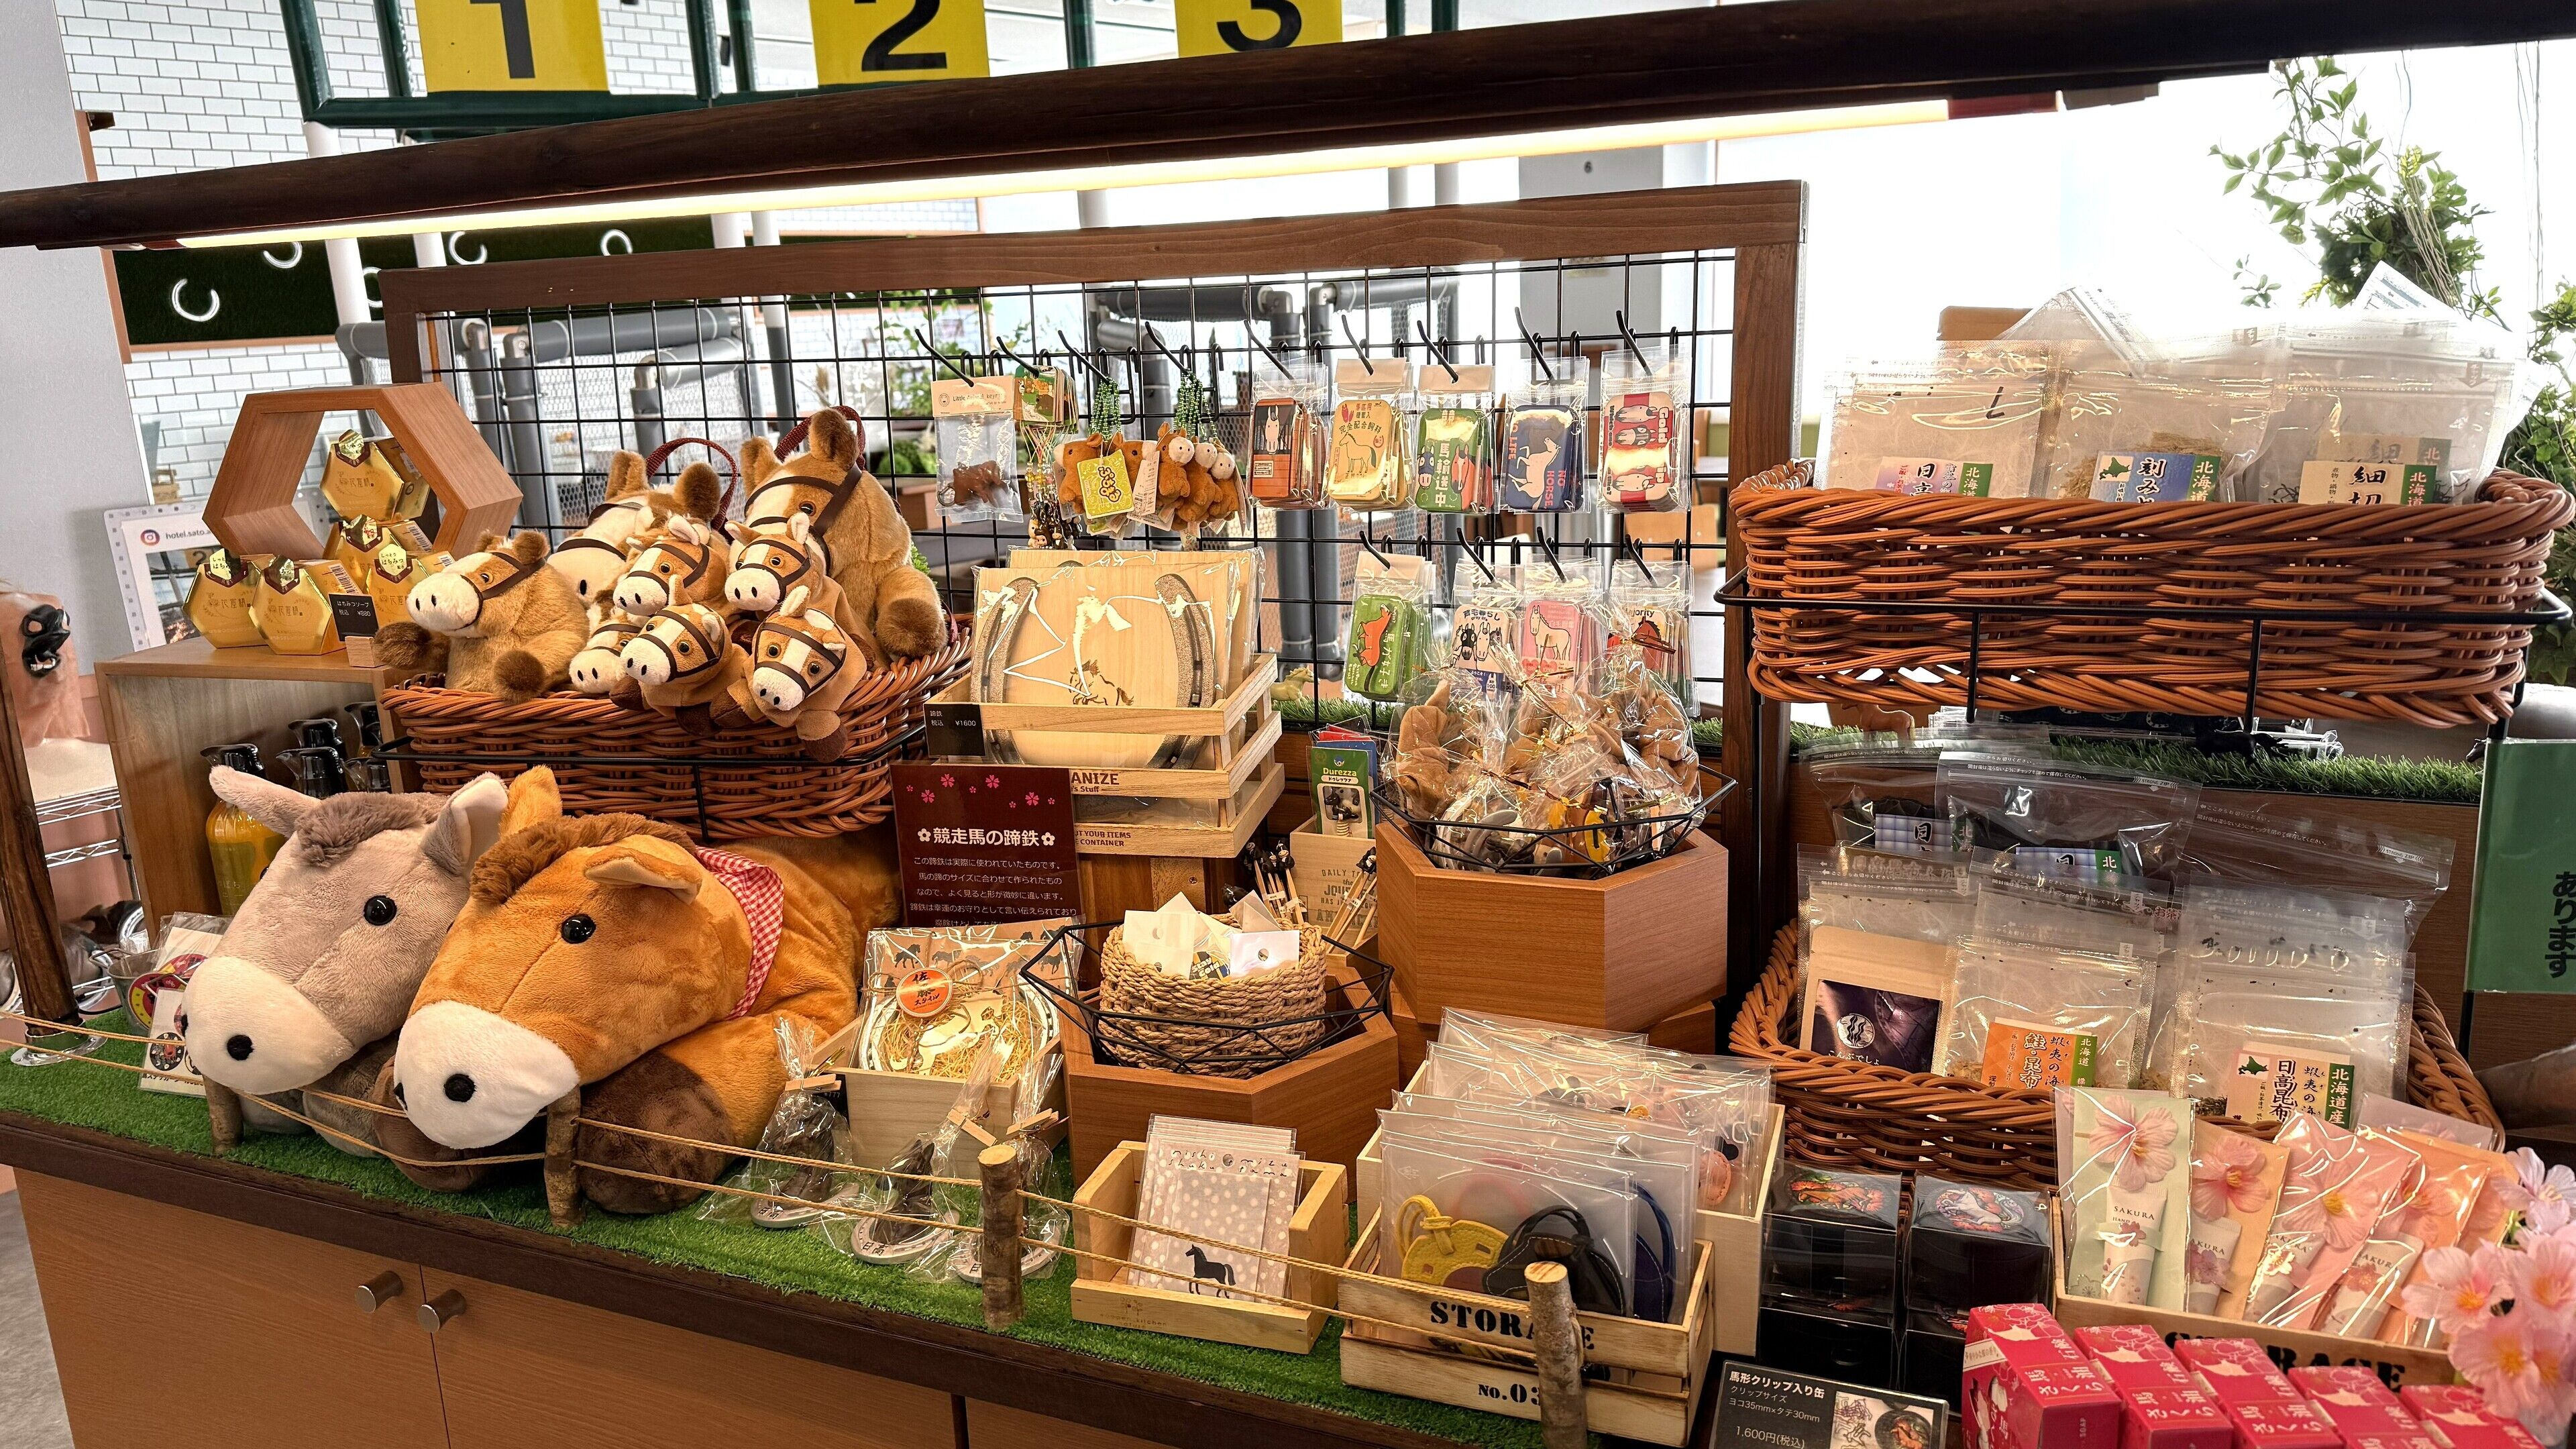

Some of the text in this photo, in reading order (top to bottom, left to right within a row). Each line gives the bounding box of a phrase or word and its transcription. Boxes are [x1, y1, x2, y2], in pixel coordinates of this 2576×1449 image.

[1216, 0, 1302, 52] 3
[855, 0, 947, 72] 2
[1338, 421, 1382, 434] 完全配合飼料
[1508, 437, 1518, 460] LIFE
[1557, 470, 1566, 488] NO
[1962, 466, 1980, 496] 北海道
[2190, 461, 2214, 502] 北海道
[2408, 472, 2427, 505] 北海道
[1323, 767, 1357, 777] Durezza
[932, 826, 1040, 847] 競走馬の蹄鉄
[1080, 839, 1124, 847] CONTAINER
[914, 856, 1060, 869] この蹄鉄は実際に使われていたものです。
[918, 872, 1063, 885] 馬の蹄のサイズに合わせて作られたもの
[1322, 869, 1346, 877] DAILY
[916, 888, 1064, 901] なので、よく見ると形が微妙に違います。
[910, 903, 1077, 916] 蹄鉄は幸運のお守りとして言い伝えられており
[2544, 871, 2576, 979] あります
[1191, 957, 1212, 973] Stay
[1199, 960, 1221, 977] Gold
[2078, 1038, 2092, 1067] 北海道
[2269, 1059, 2298, 1123] 日高昆布
[2328, 1068, 2349, 1125] 北海道産
[1173, 1149, 1216, 1159] nishi
[1169, 1158, 1215, 1170] shuku
[2114, 1205, 2155, 1220] SAKURA
[2190, 1237, 2226, 1255] AKURA
[1430, 1301, 1595, 1350] STORE
[1729, 1371, 1825, 1399] 馬形クリップ入り缶
[1730, 1385, 1788, 1403] クリップサイズ
[2039, 1381, 2104, 1396] さくら
[1729, 1397, 1820, 1423] ヨコ35mm×タテ30mm
[2146, 1407, 2217, 1419] さくら
[2252, 1420, 2324, 1434] さくら
